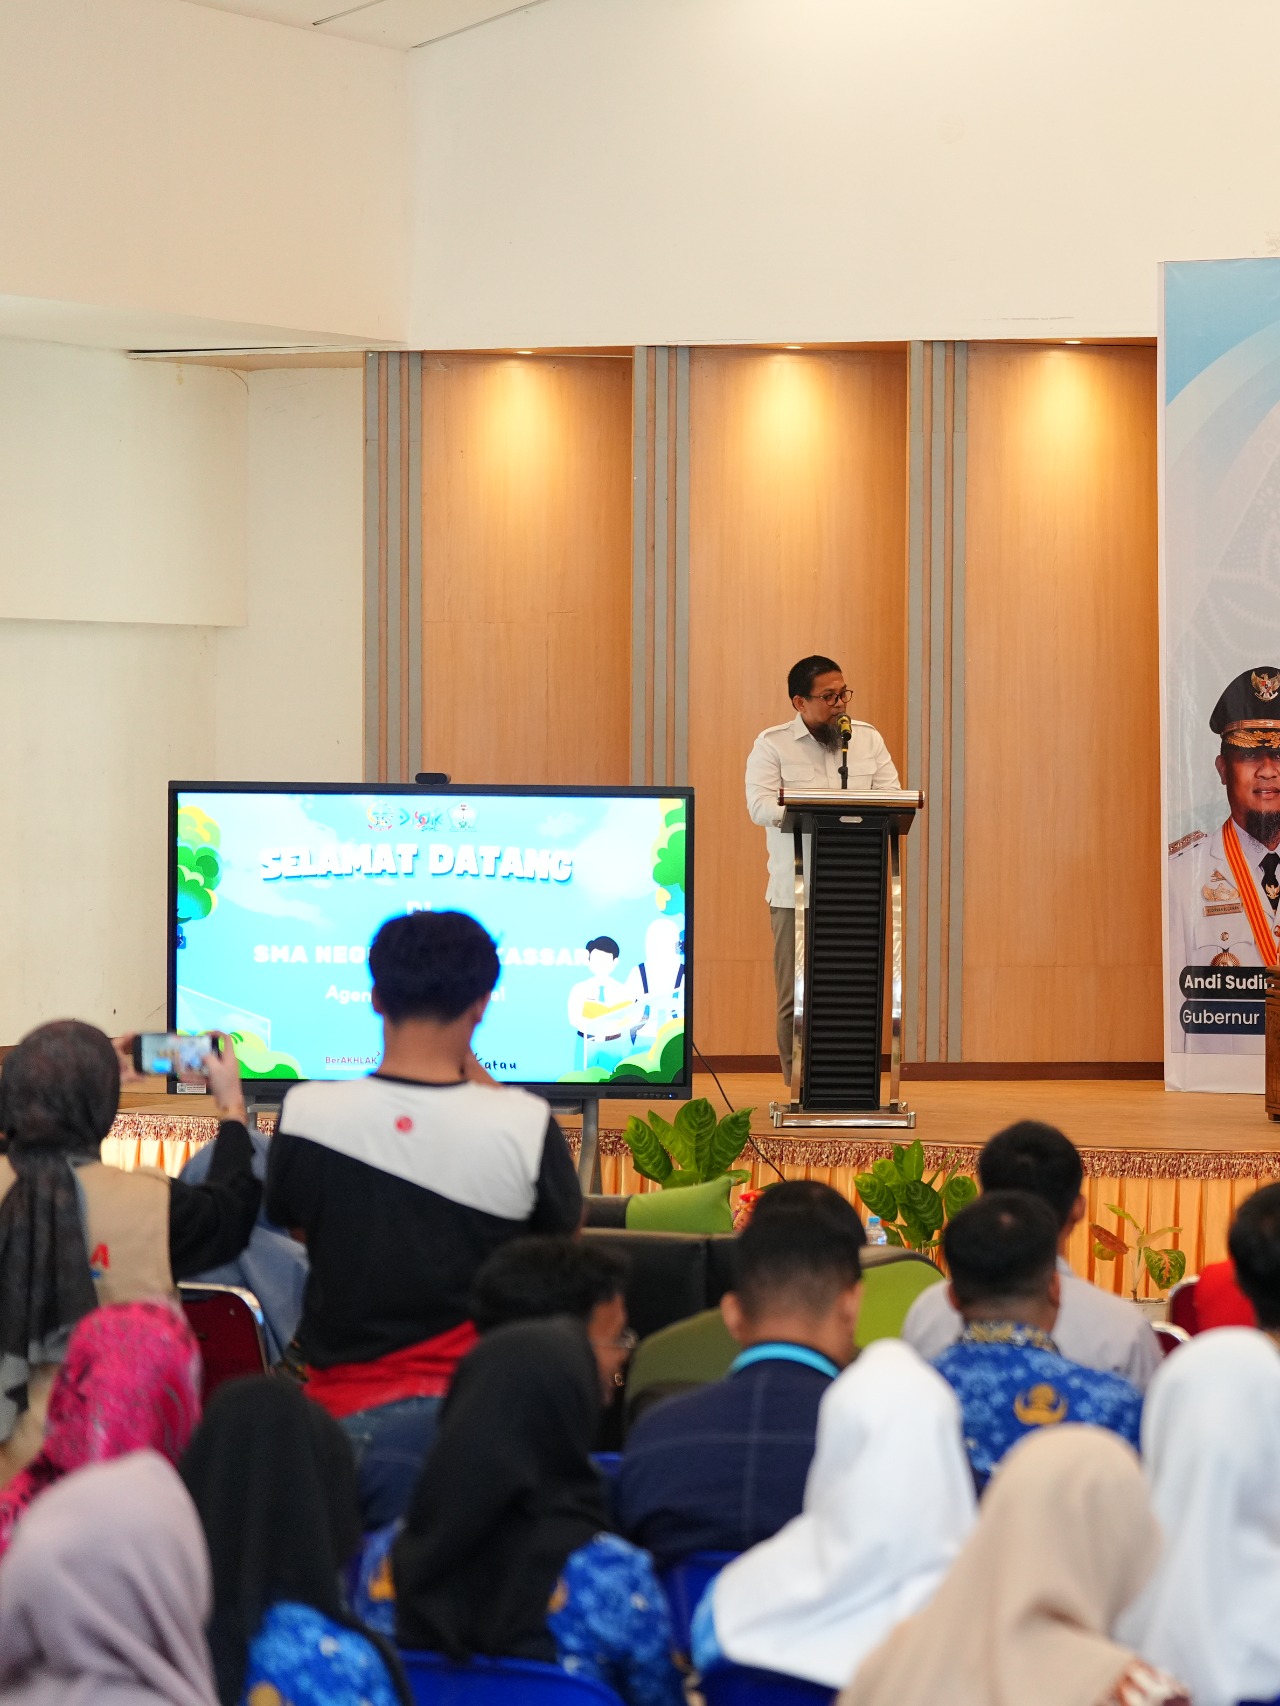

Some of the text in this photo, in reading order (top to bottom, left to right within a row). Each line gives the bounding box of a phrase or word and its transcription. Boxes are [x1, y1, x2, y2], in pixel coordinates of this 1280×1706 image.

[261, 844, 573, 884] SELAMAT DATANG
[253, 946, 308, 964] SMA
[1184, 974, 1221, 988] Andi
[325, 985, 372, 1004] Agen
[1182, 1009, 1260, 1024] Gubernur
[326, 1056, 378, 1064] BerAKHLAK
